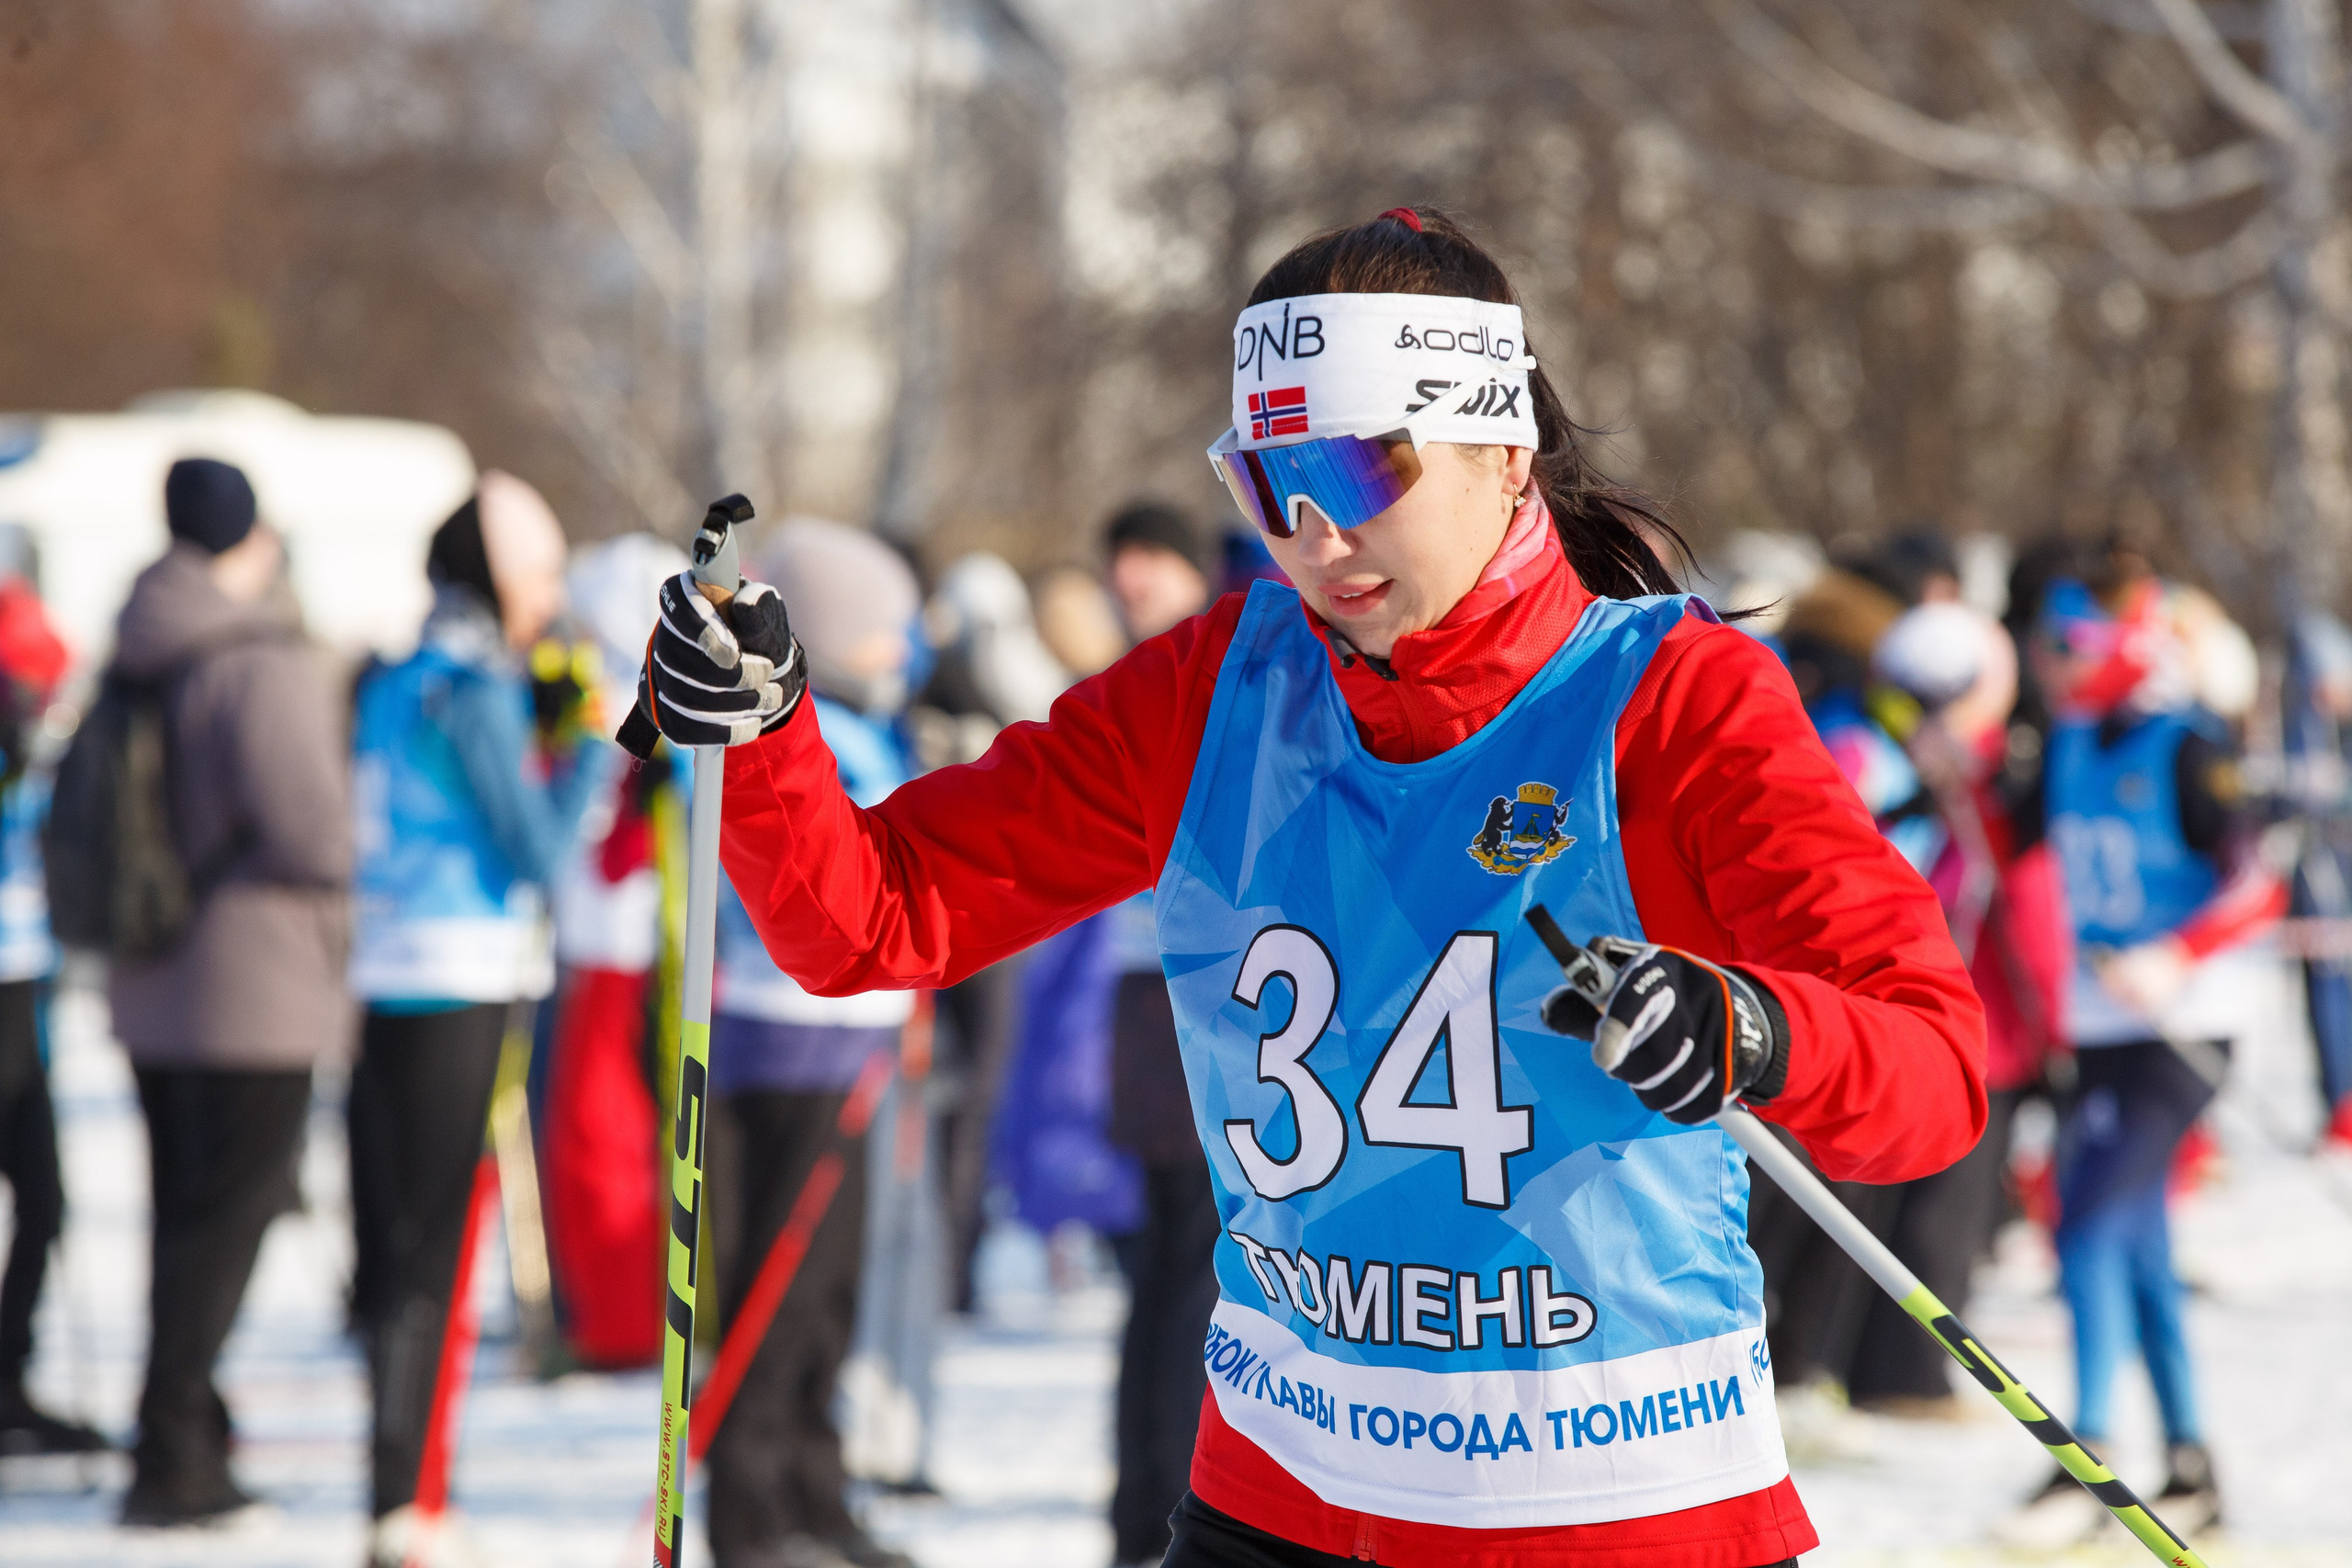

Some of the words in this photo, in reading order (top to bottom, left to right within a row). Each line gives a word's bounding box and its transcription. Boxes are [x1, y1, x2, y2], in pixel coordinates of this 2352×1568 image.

[1238, 302, 1325, 381] DNB
[1423, 325, 1514, 362] odlo
[1223, 922, 1534, 1211] 34
[1227, 1228, 1597, 1352] ТЮМЕНЬ
[1349, 1403, 1533, 1461] ГОРОДА
[1546, 1376, 1746, 1452] ТЮМЕНИ
